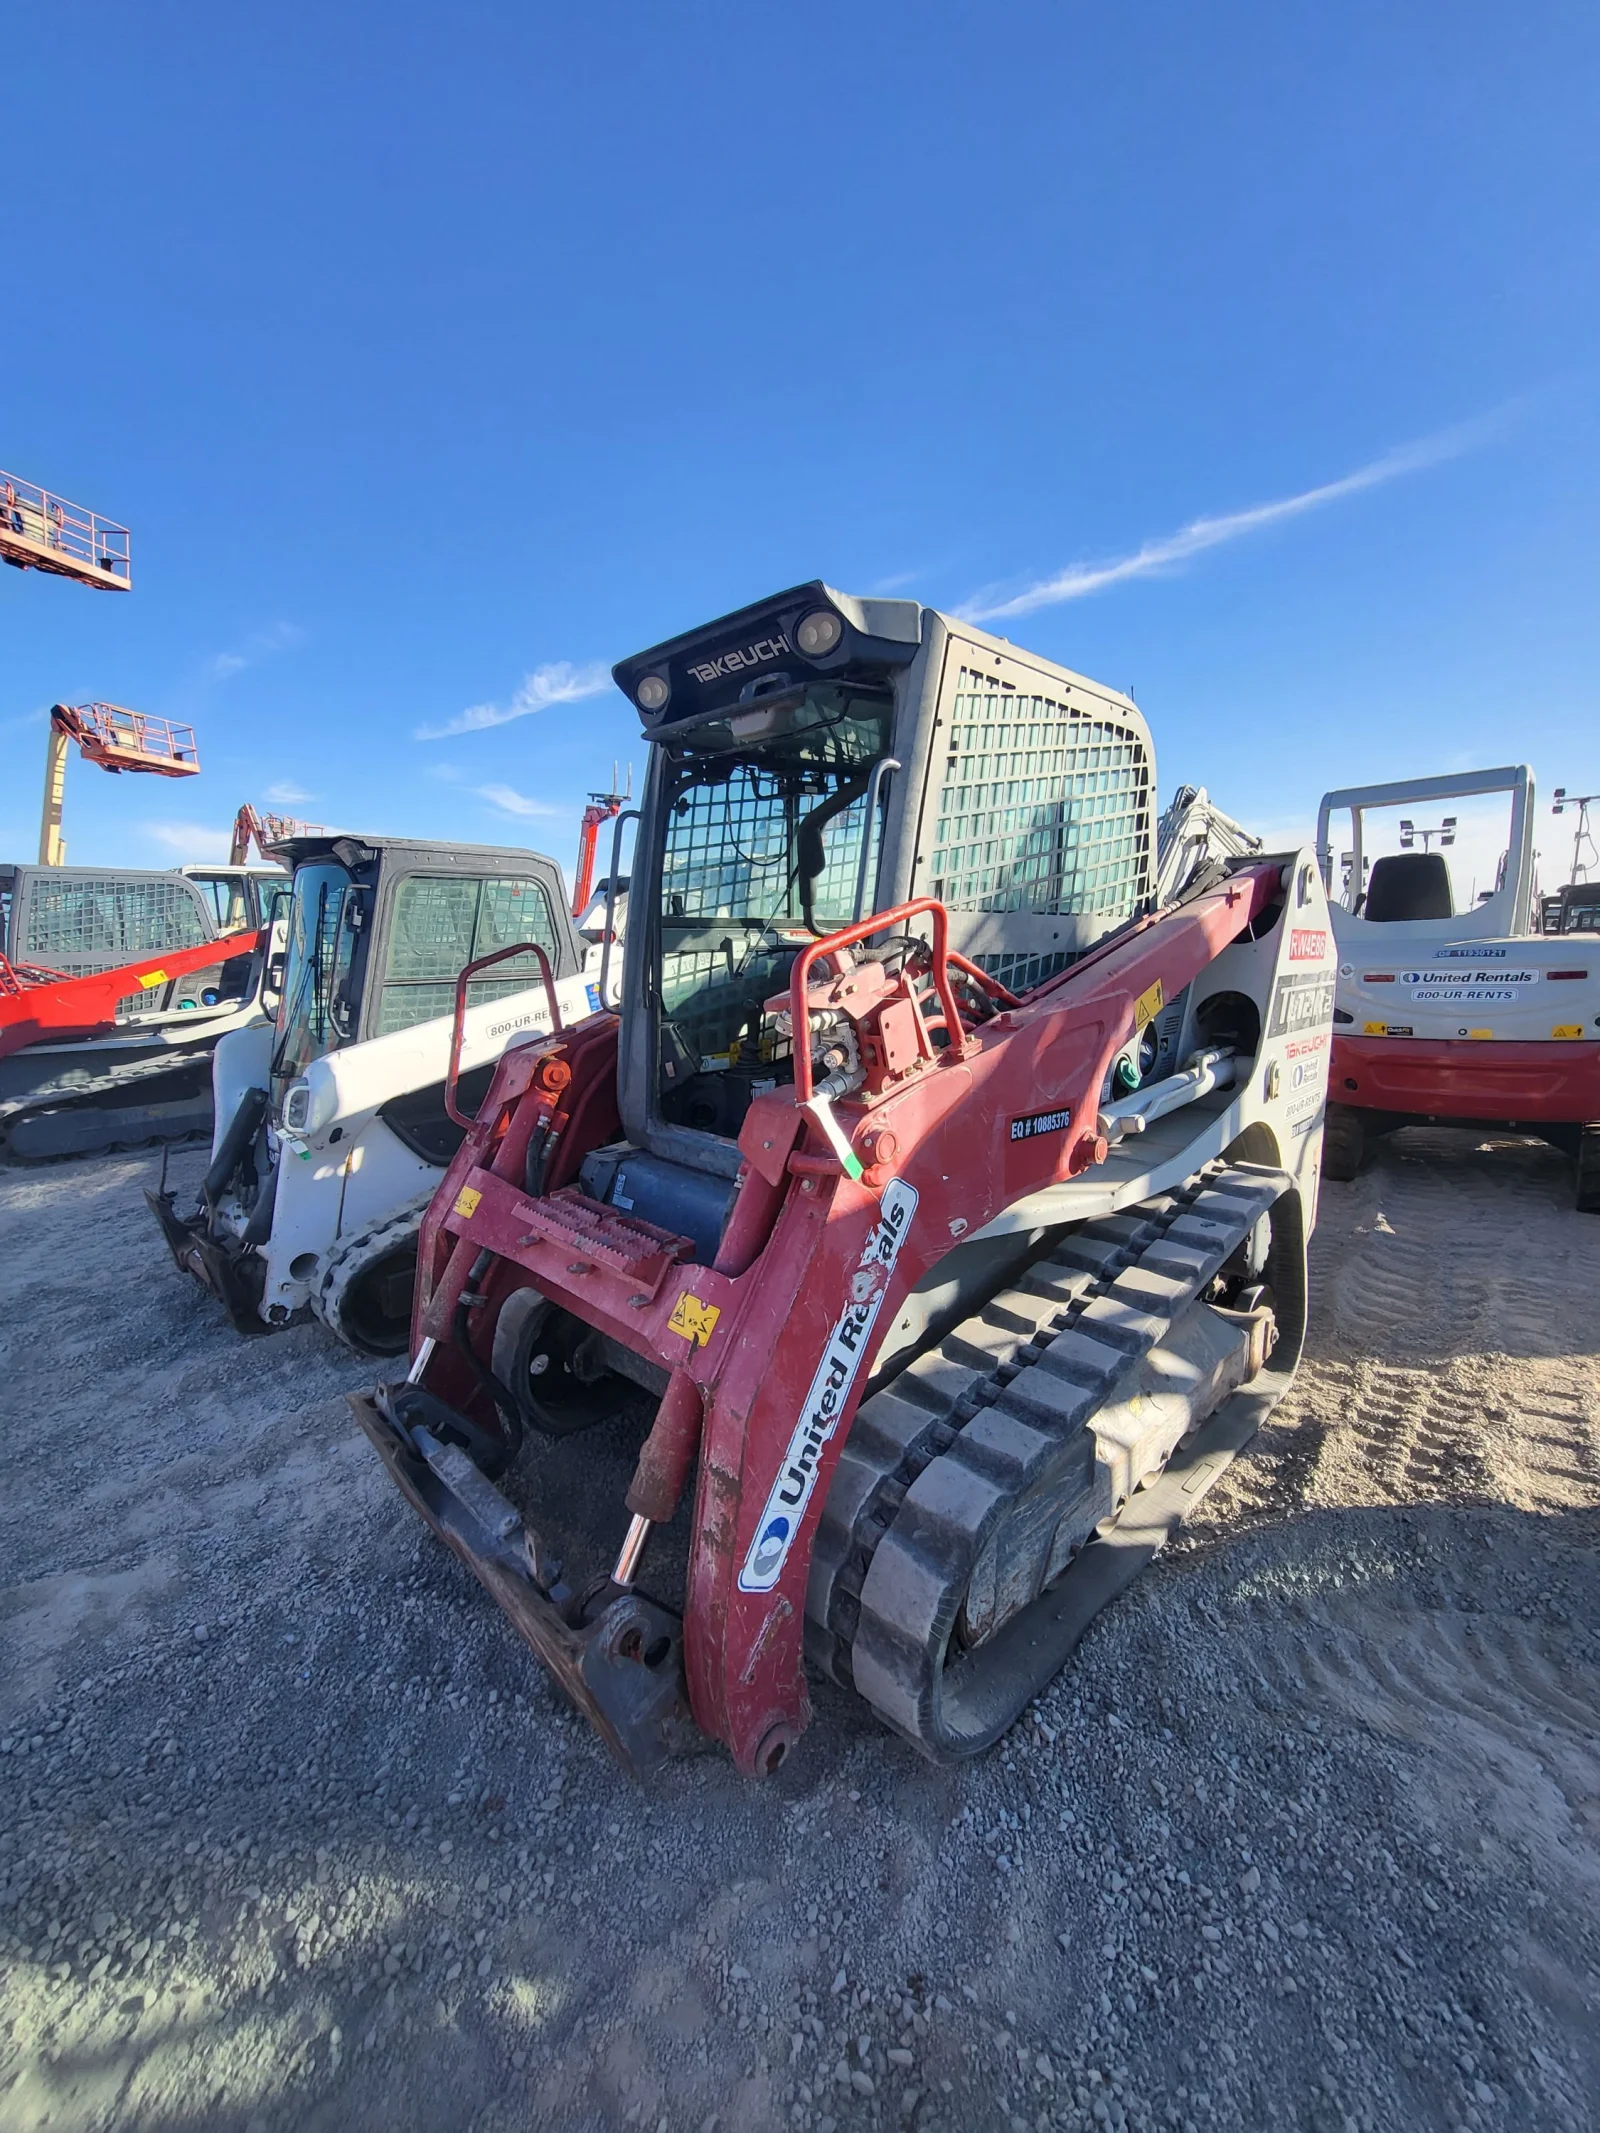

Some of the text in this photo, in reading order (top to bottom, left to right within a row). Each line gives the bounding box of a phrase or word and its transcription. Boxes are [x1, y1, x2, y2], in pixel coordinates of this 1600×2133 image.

[1290, 933, 1326, 957] RW4E86
[1423, 972, 1532, 983] United Rentals
[1417, 991, 1512, 999] 800-UR-RENTS
[491, 1003, 569, 1036] 800-UR-RES
[1011, 1111, 1070, 1139] EQ # 10885376
[780, 1203, 905, 1506] United Reals
